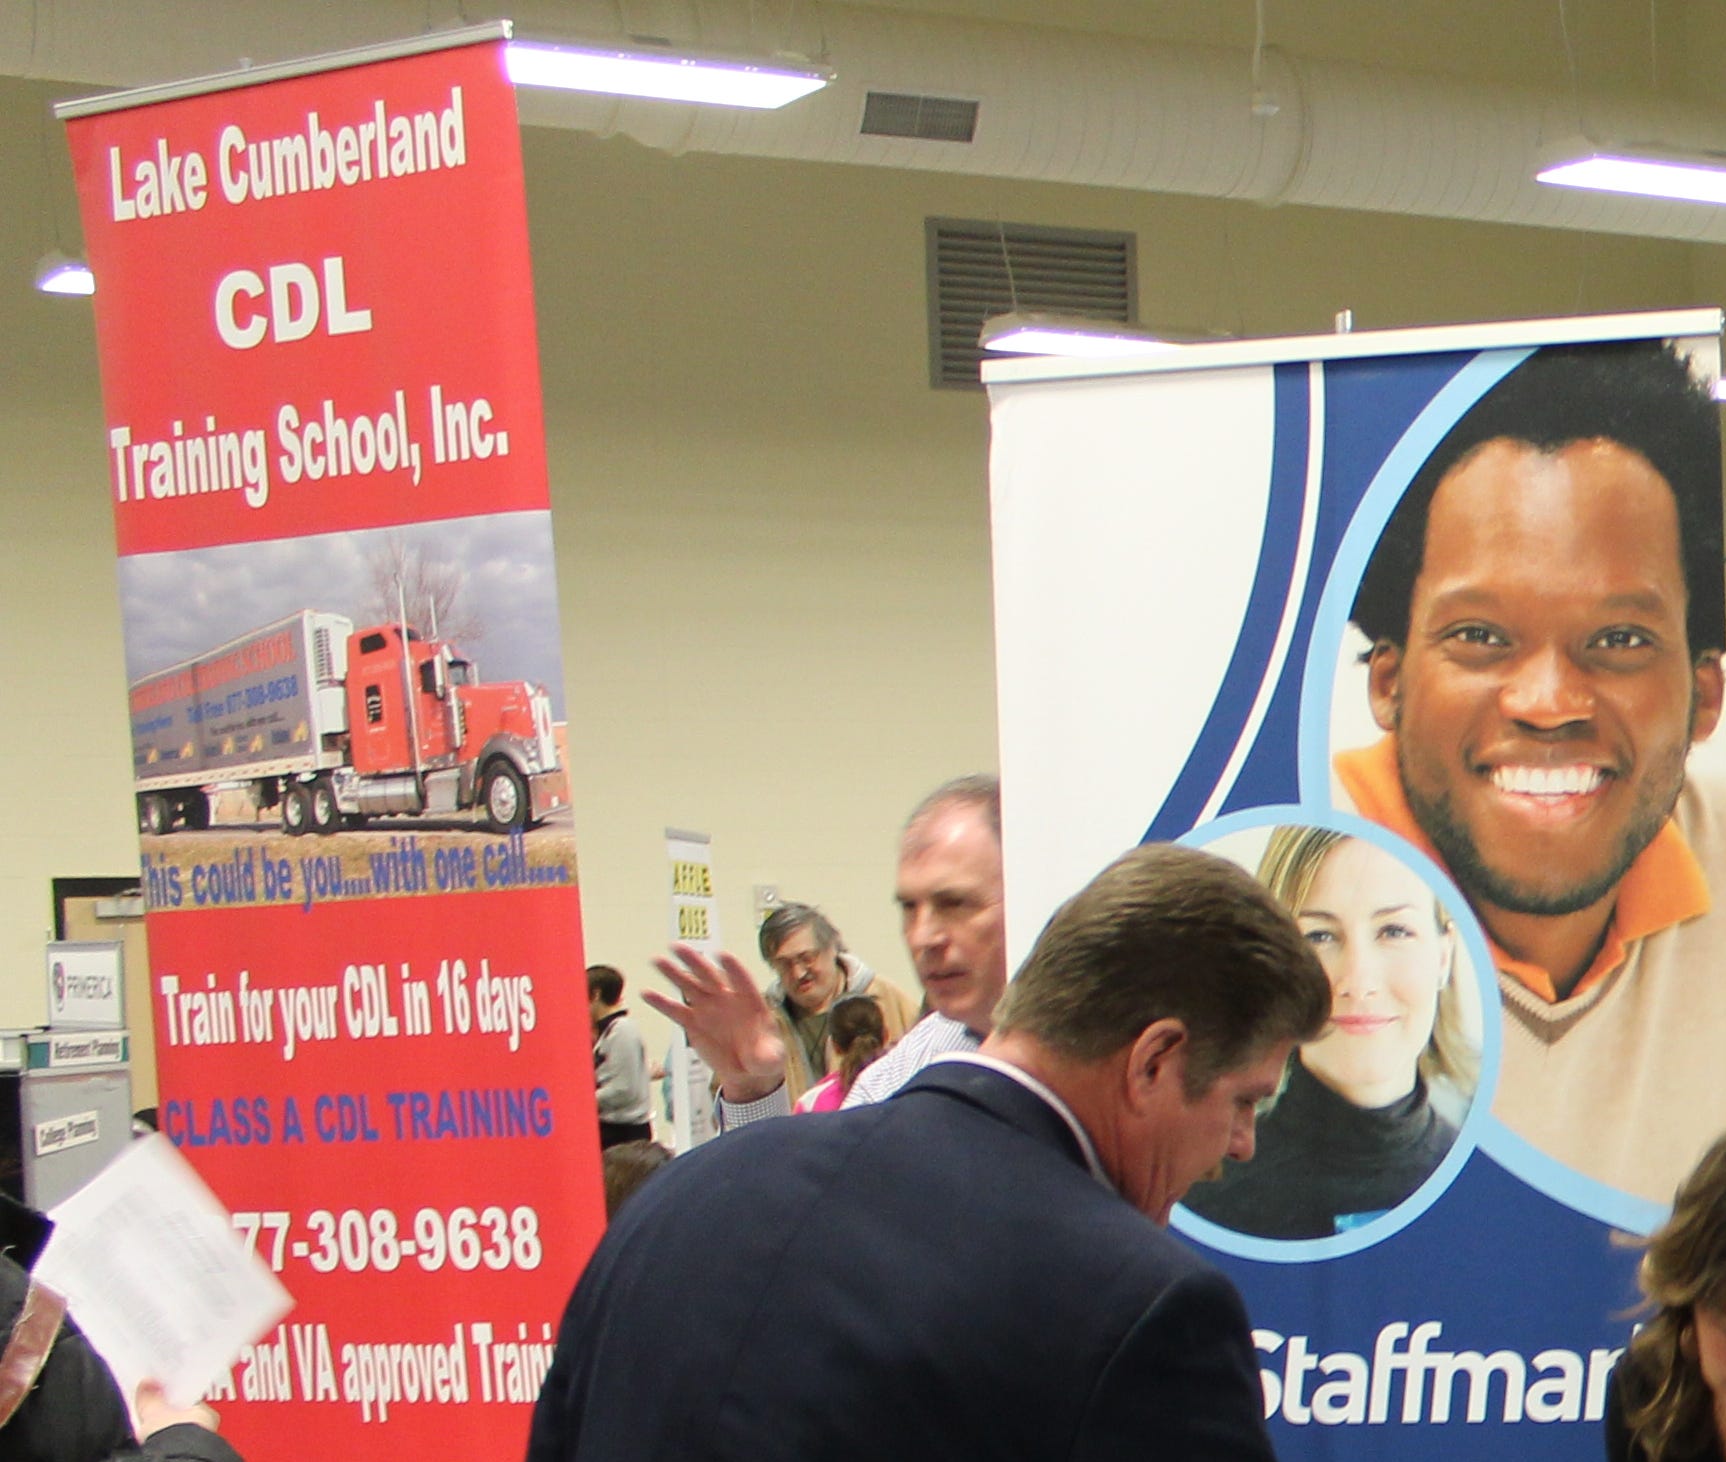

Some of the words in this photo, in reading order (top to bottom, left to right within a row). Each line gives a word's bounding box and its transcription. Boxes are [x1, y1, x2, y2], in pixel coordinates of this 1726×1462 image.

[110, 137, 208, 222] Lake
[219, 86, 467, 206] Cumberland
[214, 256, 373, 350] CDL
[110, 416, 270, 509] Training
[277, 389, 423, 487] School,
[430, 384, 509, 464] Inc.
[191, 846, 256, 906] could
[261, 846, 293, 901] be
[434, 845, 476, 890] one
[160, 973, 237, 1047] Train
[239, 970, 275, 1042] for
[278, 983, 339, 1061] your
[343, 963, 399, 1039] CDL
[402, 962, 432, 1036] in
[437, 958, 471, 1035] 16
[475, 958, 537, 1052] days
[163, 1094, 273, 1149] CLASS
[282, 1094, 305, 1144] A
[313, 1093, 380, 1143] CDL
[387, 1086, 553, 1142] TRAINING
[232, 1205, 543, 1274] 77-308-9638
[240, 1323, 293, 1402] and
[292, 1323, 339, 1402] VA
[341, 1322, 469, 1424] approved
[471, 1322, 556, 1404] Traini
[1250, 1320, 1643, 1426] Staffmar
